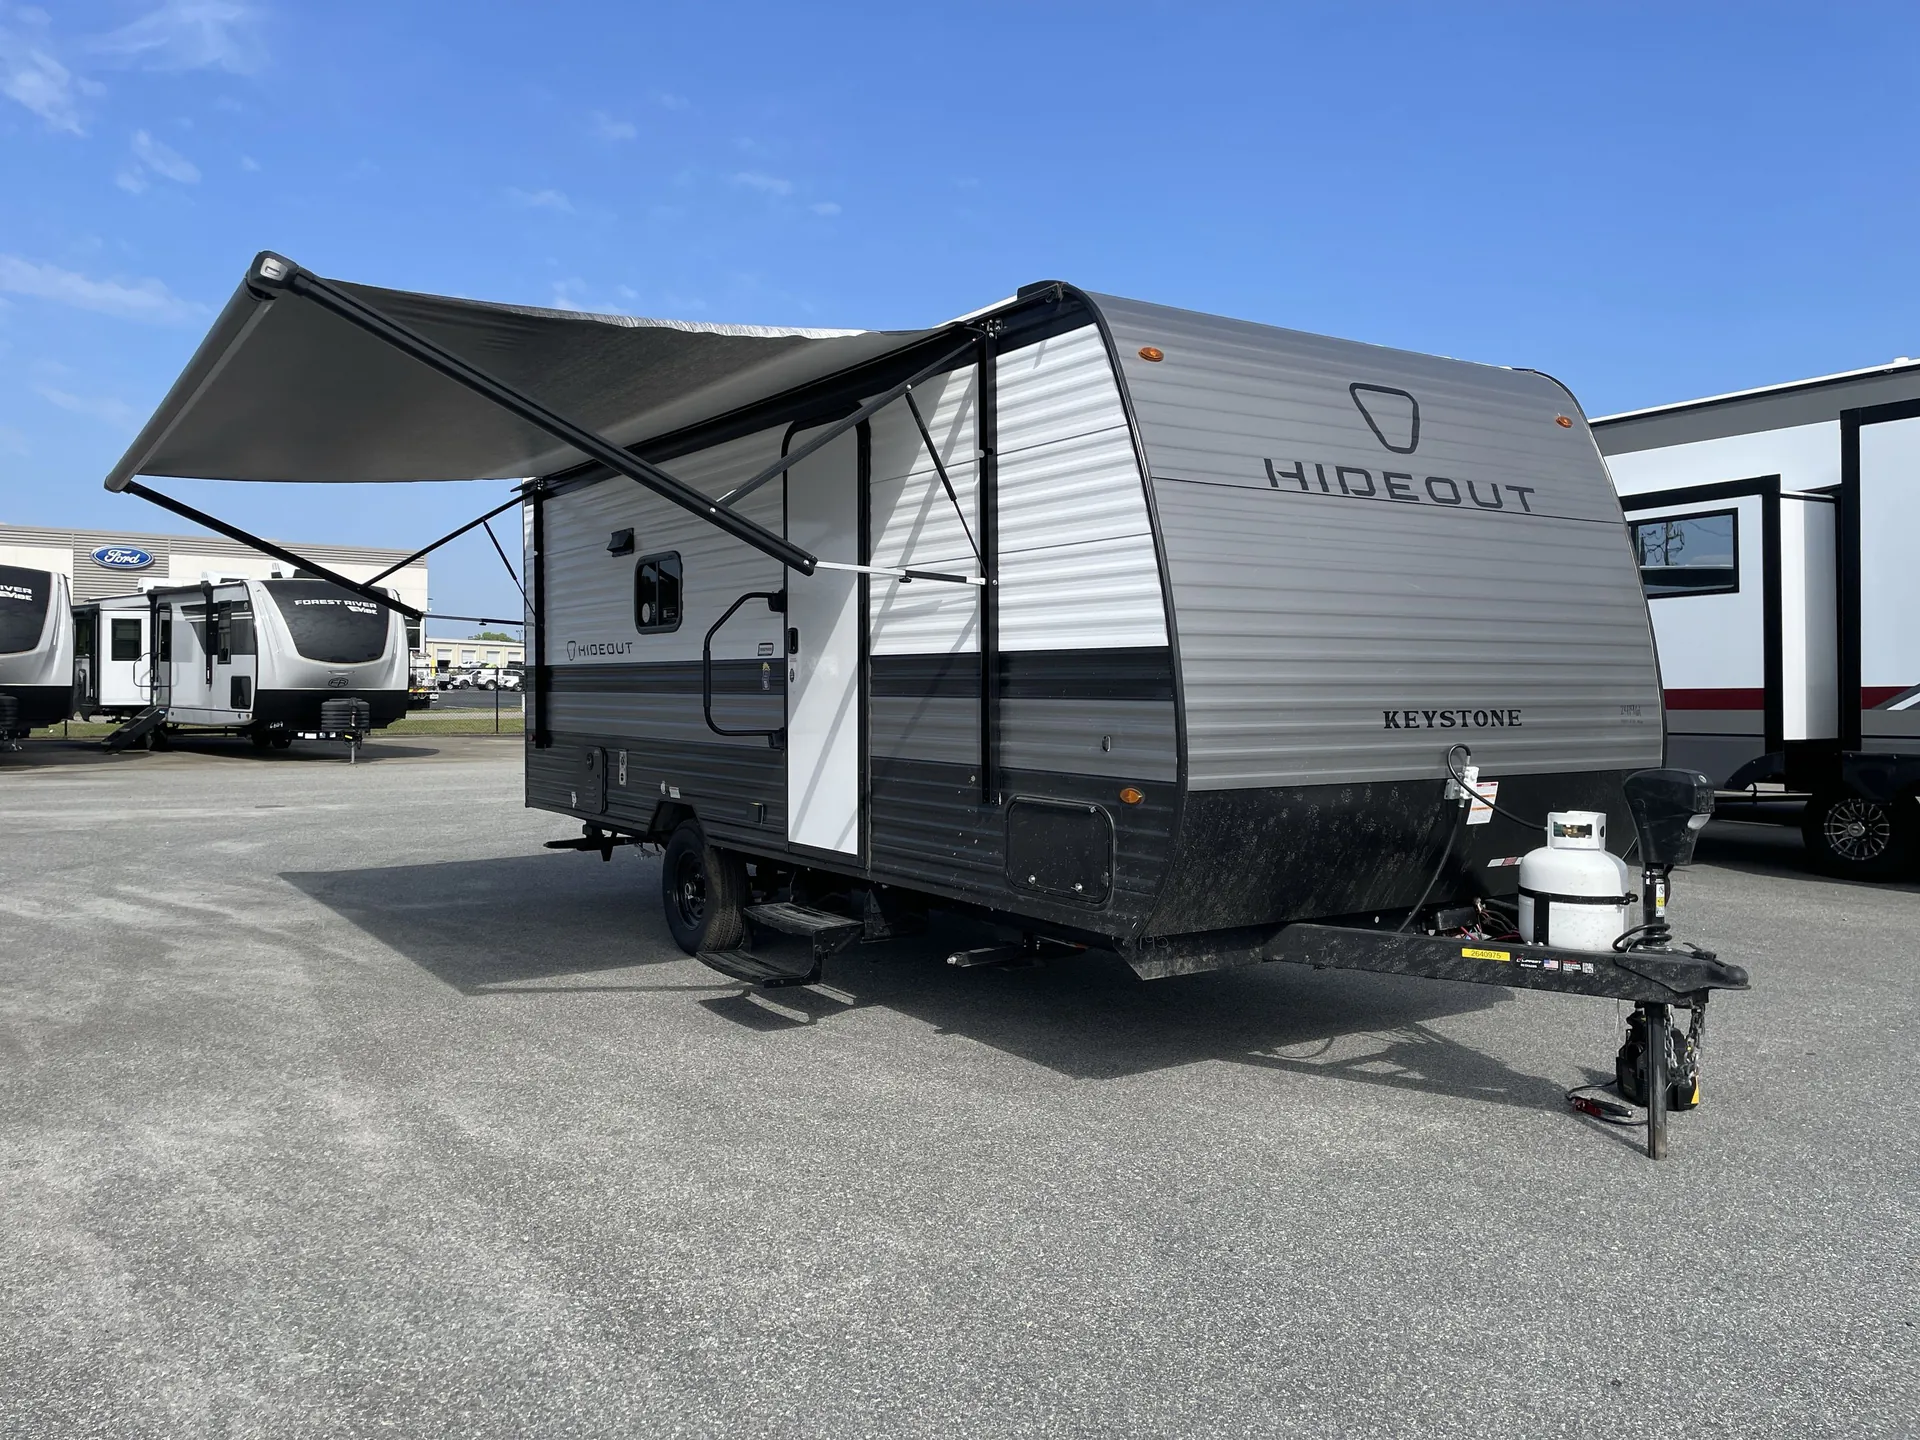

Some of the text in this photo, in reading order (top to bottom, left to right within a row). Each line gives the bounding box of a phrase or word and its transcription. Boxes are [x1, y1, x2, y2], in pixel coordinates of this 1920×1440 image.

[1263, 457, 1536, 512] HIDEOUT
[104, 549, 141, 564] Ford
[0, 585, 33, 594] IVER
[343, 600, 377, 609] RIVER
[578, 642, 633, 656] HIDEOUT
[1383, 709, 1523, 729] KEYSTONE
[1471, 950, 1502, 960] 2640975
